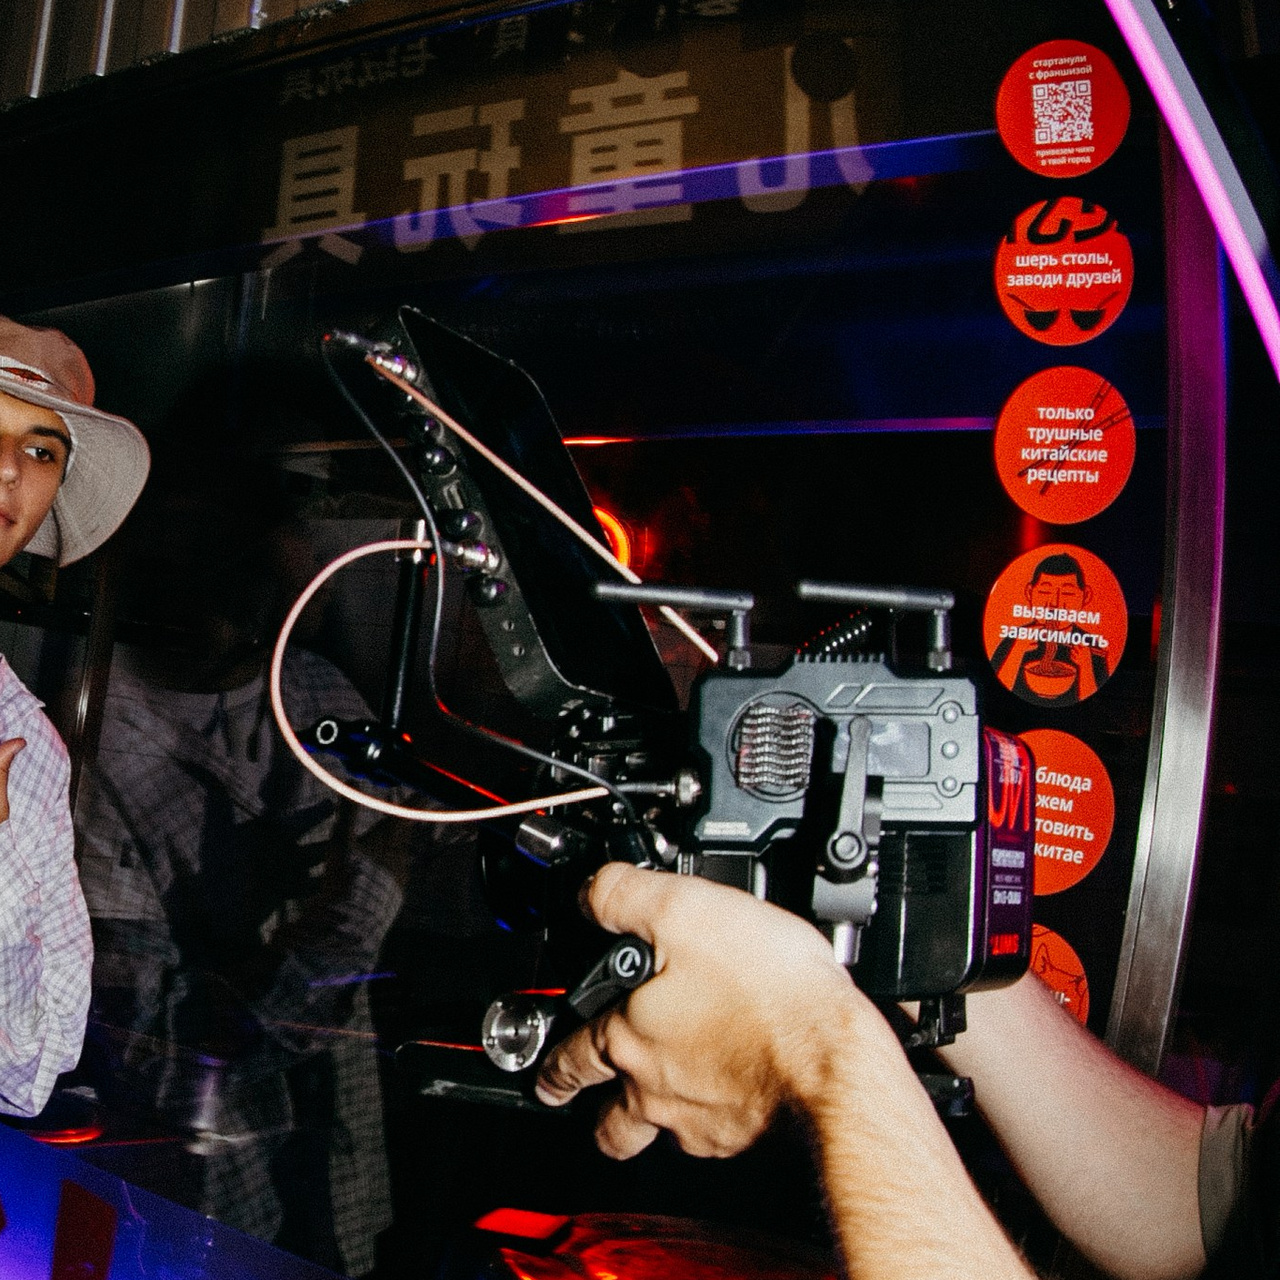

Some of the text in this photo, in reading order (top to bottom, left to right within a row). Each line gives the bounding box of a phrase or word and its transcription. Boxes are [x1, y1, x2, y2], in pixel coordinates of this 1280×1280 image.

[1032, 55, 1087, 69] стартанули
[1035, 65, 1093, 81] франшизой
[1015, 252, 1113, 270] шерь столы,
[1007, 267, 1122, 289] заводи друзей
[1037, 405, 1095, 421] только
[1027, 425, 1103, 444] трушные
[1021, 443, 1108, 464] китайские
[1027, 465, 1099, 485] рецепты
[1013, 604, 1100, 626] вызываем
[999, 622, 1109, 649] зависимость
[1035, 766, 1092, 794] блюда
[1035, 794, 1074, 813] жем
[1035, 818, 1095, 841] товить
[1034, 843, 1084, 865] китае
